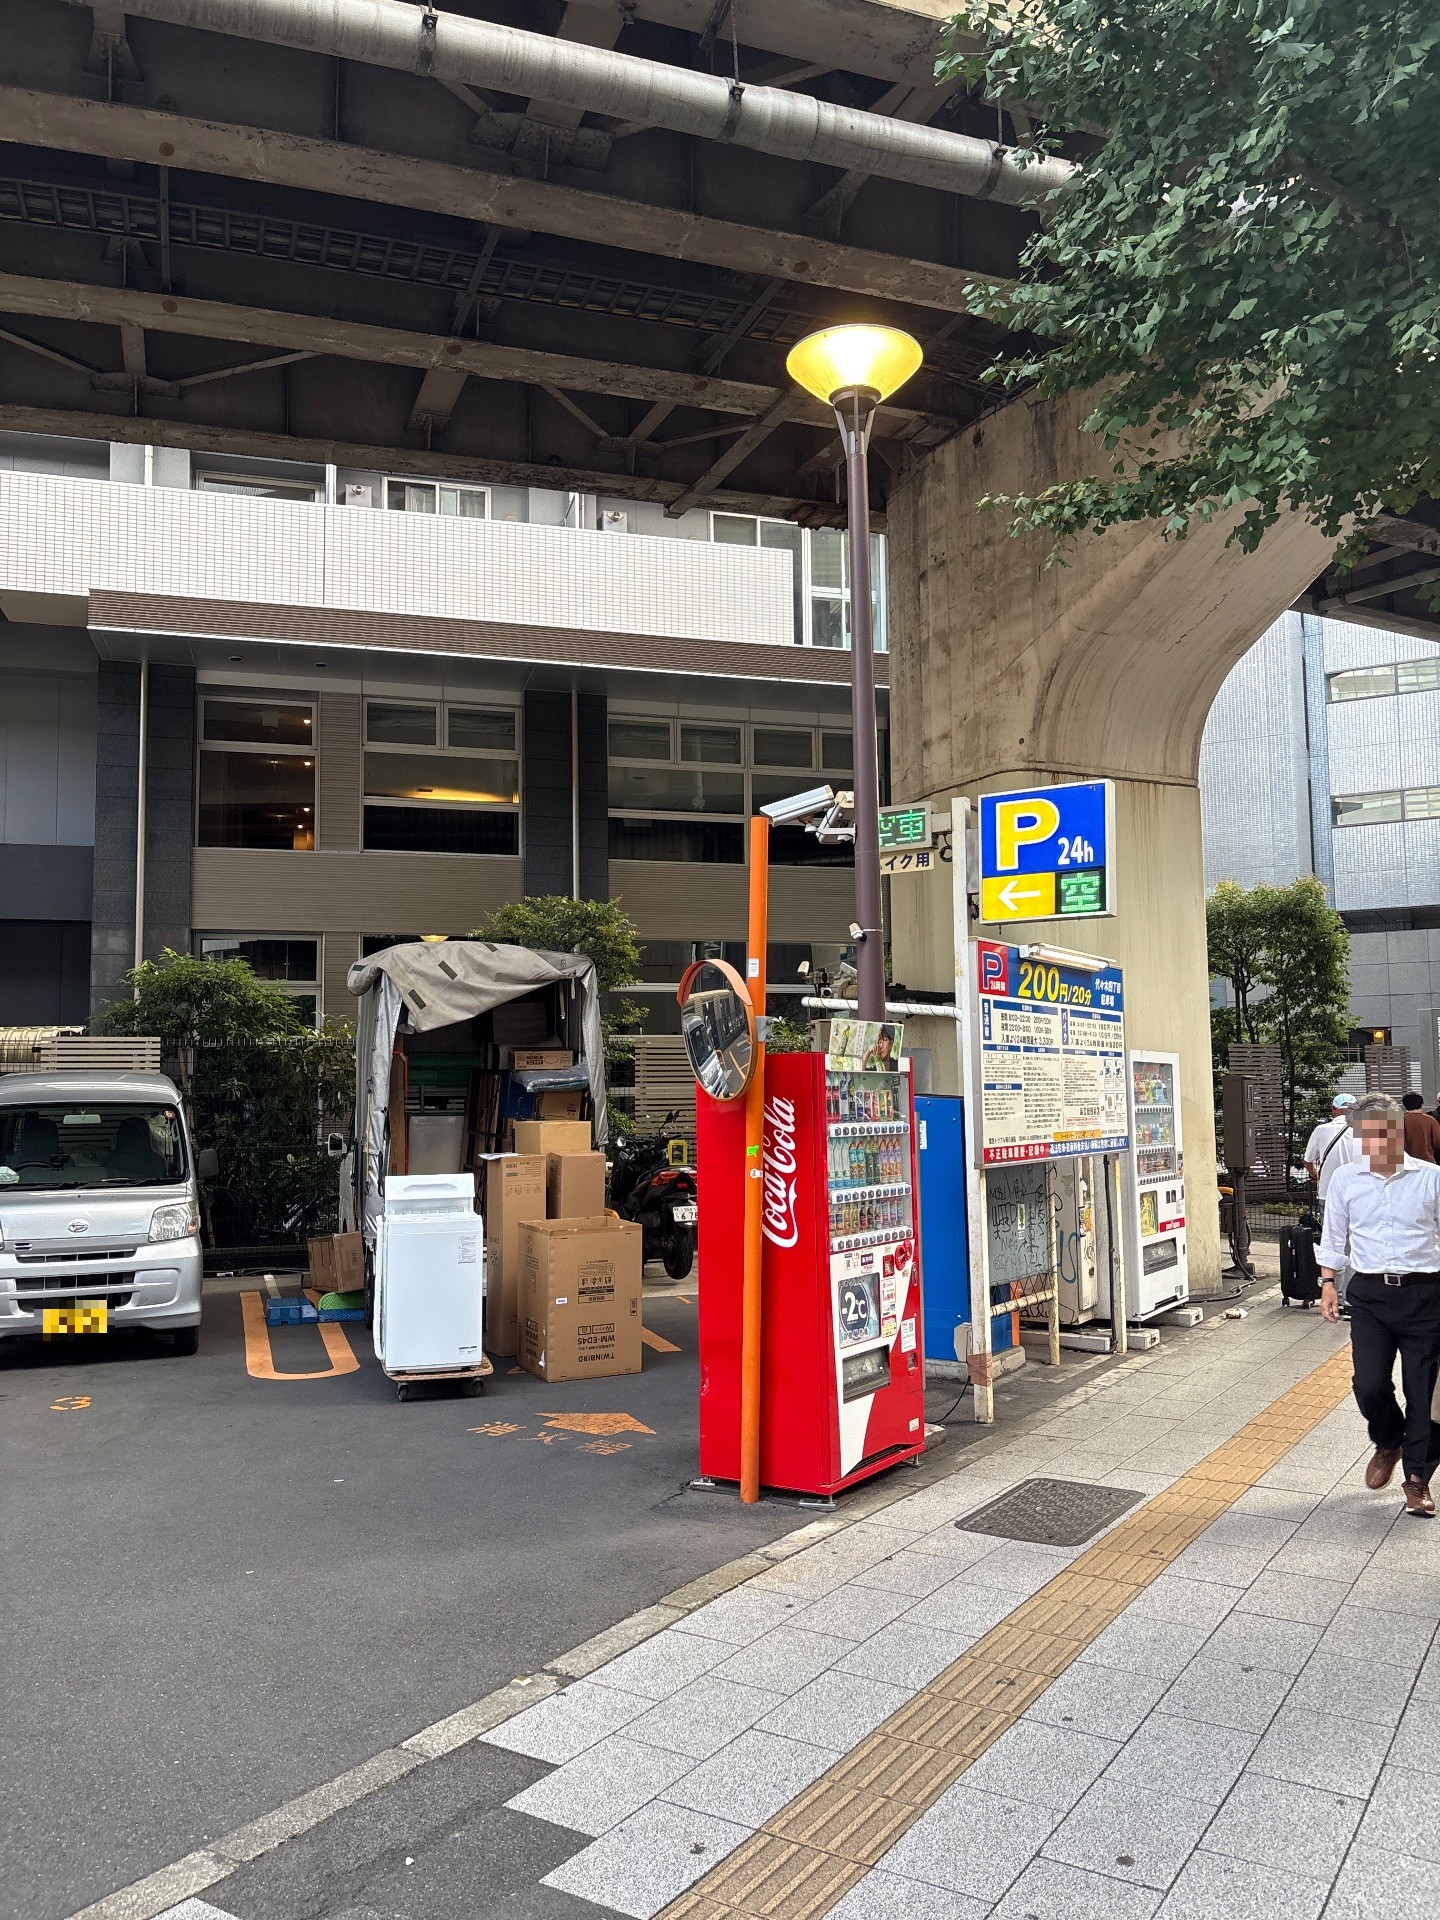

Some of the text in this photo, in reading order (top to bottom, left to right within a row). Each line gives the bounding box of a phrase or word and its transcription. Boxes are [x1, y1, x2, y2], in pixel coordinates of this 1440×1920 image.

[995, 798, 1060, 871] P
[1057, 835, 1094, 865] 24h
[880, 852, 930, 871] イク用
[1060, 873, 1102, 913] 空
[982, 951, 1003, 990] P
[1018, 961, 1092, 1006] 200円/20分
[762, 1096, 799, 1248] Coca-Cola
[577, 1334, 615, 1346] WM-ED45
[578, 1352, 615, 1363] TWINBIRD
